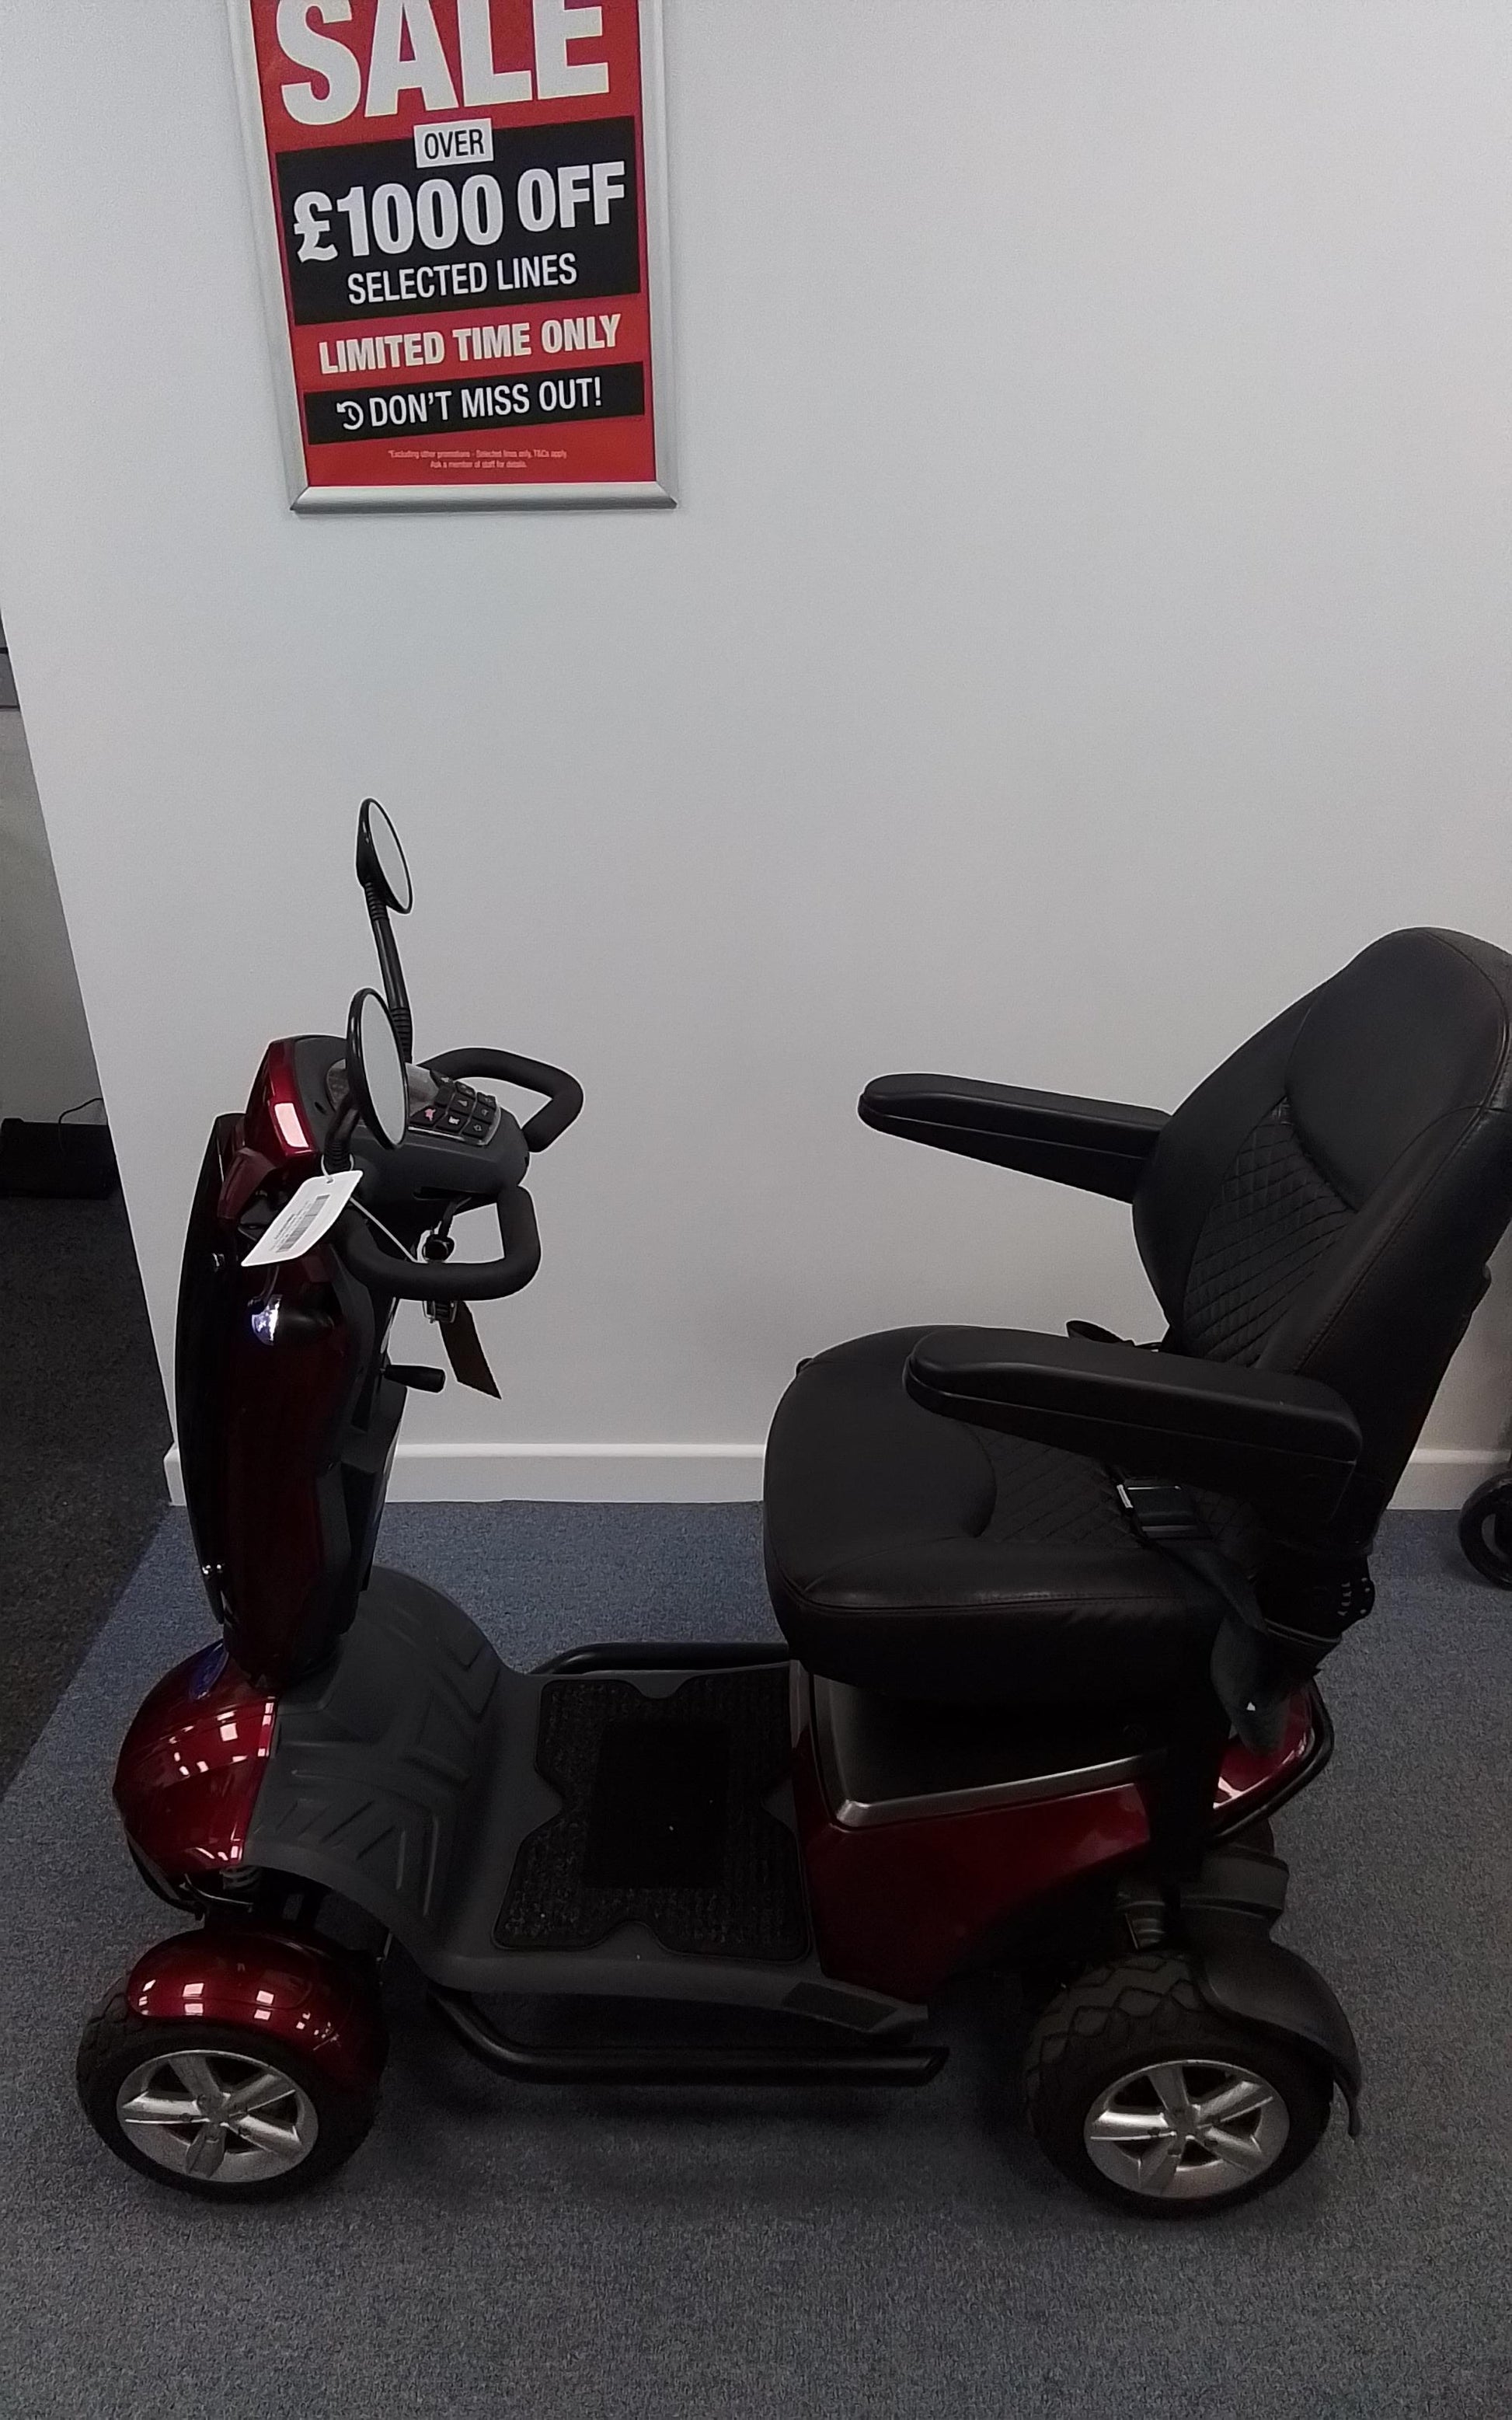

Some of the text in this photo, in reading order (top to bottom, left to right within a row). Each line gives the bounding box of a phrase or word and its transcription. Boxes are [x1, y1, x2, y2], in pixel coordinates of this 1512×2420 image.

[276, 0, 610, 126] SALE
[423, 127, 485, 160] OVER
[292, 161, 625, 263] £1000 OFF
[347, 253, 577, 305] SELECTED LINES
[318, 313, 622, 375] LIMITED TIME ONLY
[369, 376, 603, 427] DON'T MISS OUT!
